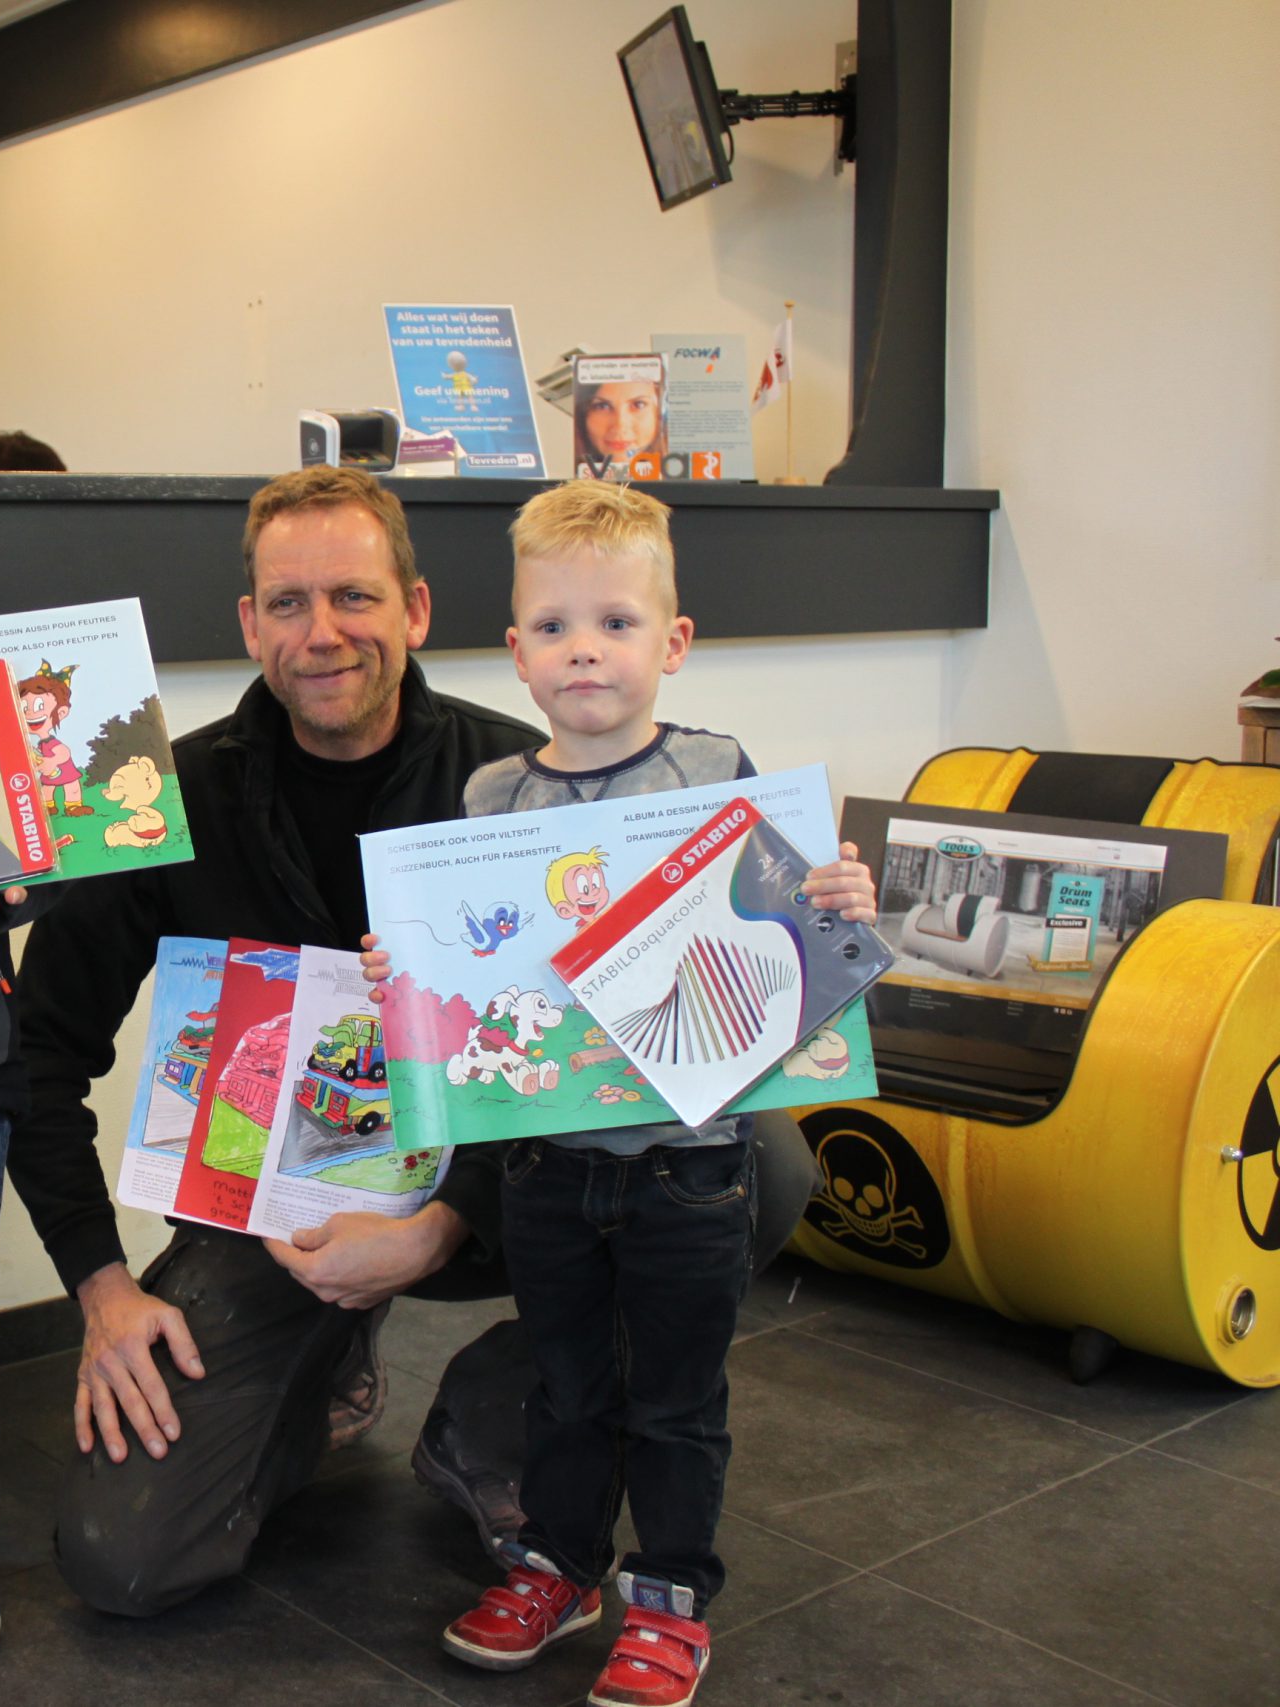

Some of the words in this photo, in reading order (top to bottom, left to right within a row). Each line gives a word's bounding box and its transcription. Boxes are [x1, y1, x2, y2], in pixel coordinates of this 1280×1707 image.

[396, 312, 425, 322] Alles
[427, 313, 448, 322] wat
[450, 312, 468, 324] wij
[470, 313, 499, 323] doen
[400, 325, 430, 334] staat
[432, 325, 444, 334] in
[445, 325, 465, 335] het
[466, 325, 500, 335] teken
[392, 338, 414, 346] van
[416, 338, 433, 346] uw
[435, 337, 513, 347] tevredenheid
[673, 347, 720, 360] FOCWA
[414, 386, 442, 396] Geef
[25, 624, 50, 634] AUSSI
[52, 620, 76, 630] POUR
[78, 615, 117, 626] FEUTRES
[22, 640, 45, 650] ALSO
[46, 639, 65, 648] FOR
[66, 634, 99, 645] FELTTIP
[100, 632, 119, 641] PEN
[623, 811, 655, 823] ALBUM
[657, 809, 664, 818] A
[666, 804, 700, 817] DESSIN
[760, 787, 801, 801] FEUTRES
[784, 809, 803, 818] PEN
[16, 793, 43, 862] STABILO
[387, 840, 446, 855] SCHETSBOEK
[448, 837, 468, 846] OOK
[470, 832, 496, 843] VOOR
[498, 827, 541, 839] VILTSTIFT
[626, 826, 696, 843] DRAWINGBOOK
[682, 808, 747, 867] STABILO
[944, 842, 976, 852] TOOLS
[455, 856, 480, 866] AUCH
[482, 852, 501, 862] FÜR
[502, 845, 562, 860] FASERSTIFTE
[758, 854, 774, 870] 24
[1059, 886, 1093, 898] Drum
[1058, 895, 1091, 907] Seats
[1050, 919, 1083, 927] Exclusive
